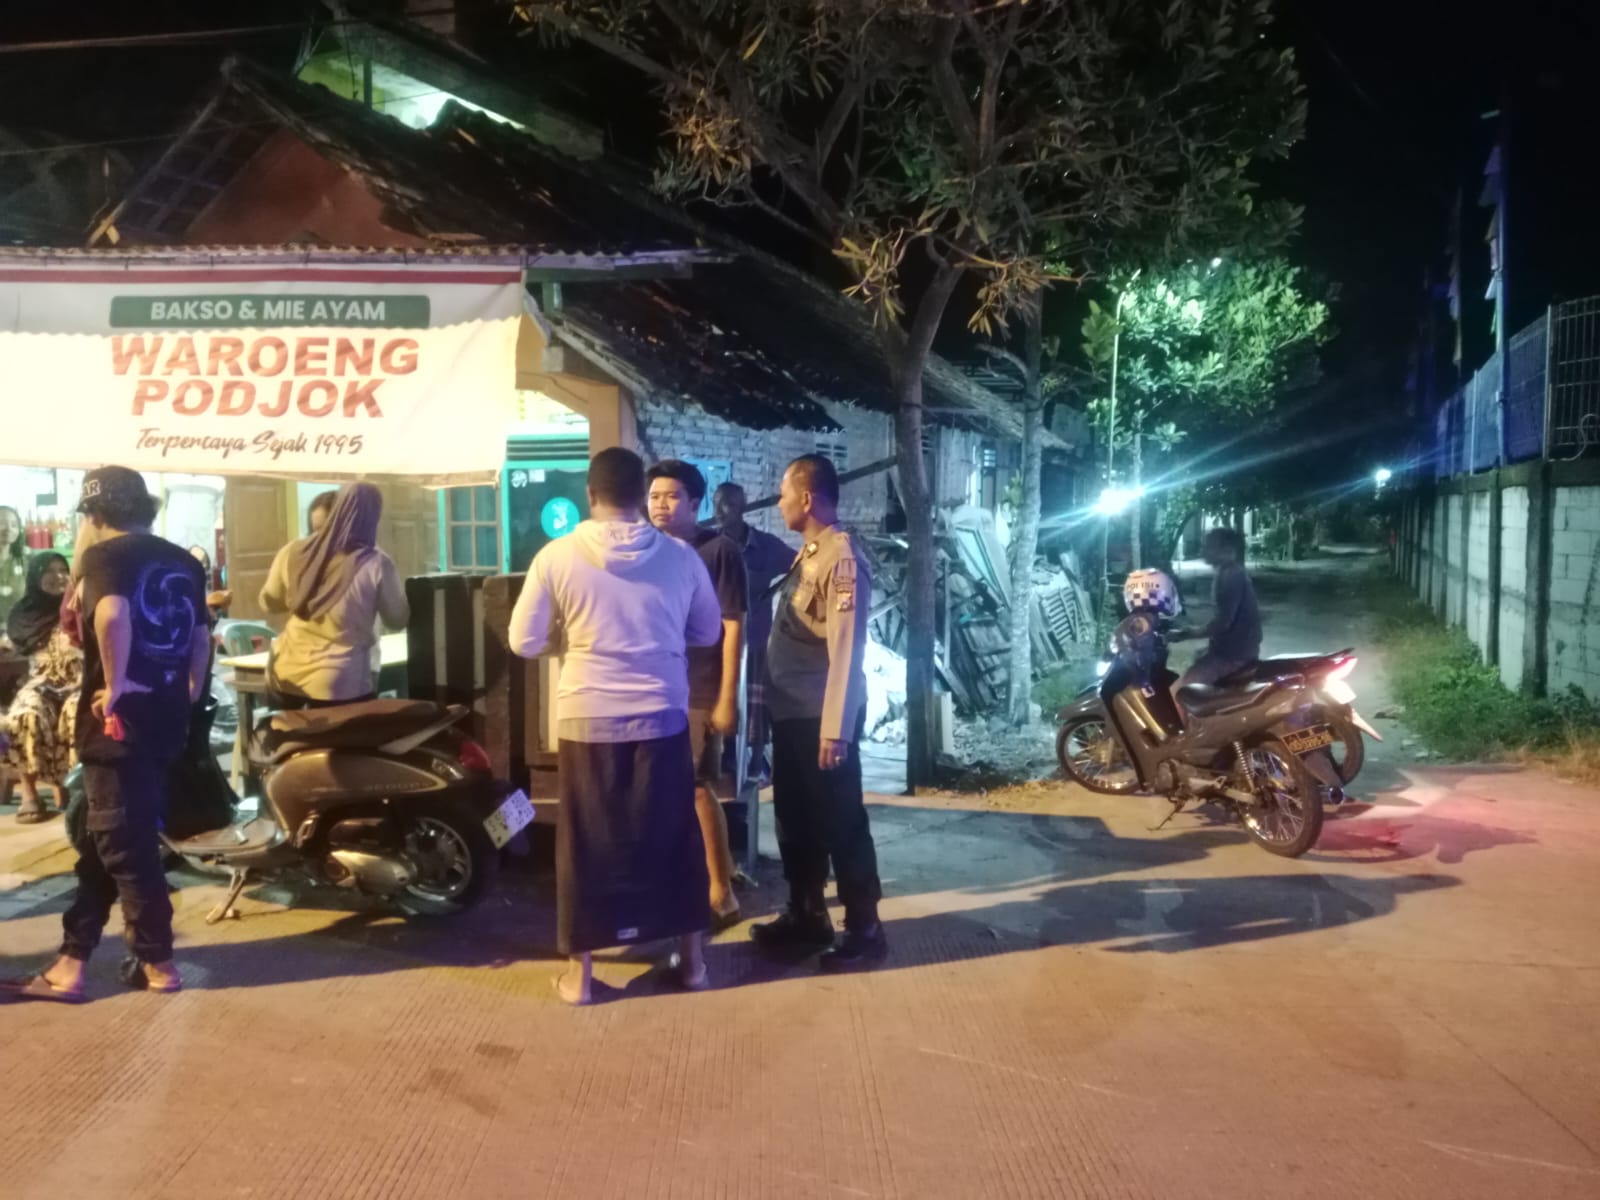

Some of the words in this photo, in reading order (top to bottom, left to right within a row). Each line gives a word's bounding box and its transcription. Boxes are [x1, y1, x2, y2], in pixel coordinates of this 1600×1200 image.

[151, 300, 232, 320] BAKSO
[238, 300, 256, 320] &
[263, 300, 305, 320] MIE
[310, 300, 386, 321] AYAM
[111, 335, 419, 377] WAROENG
[131, 378, 386, 418] PODJOK
[252, 430, 307, 460] Sejak
[314, 434, 363, 455] 1995
